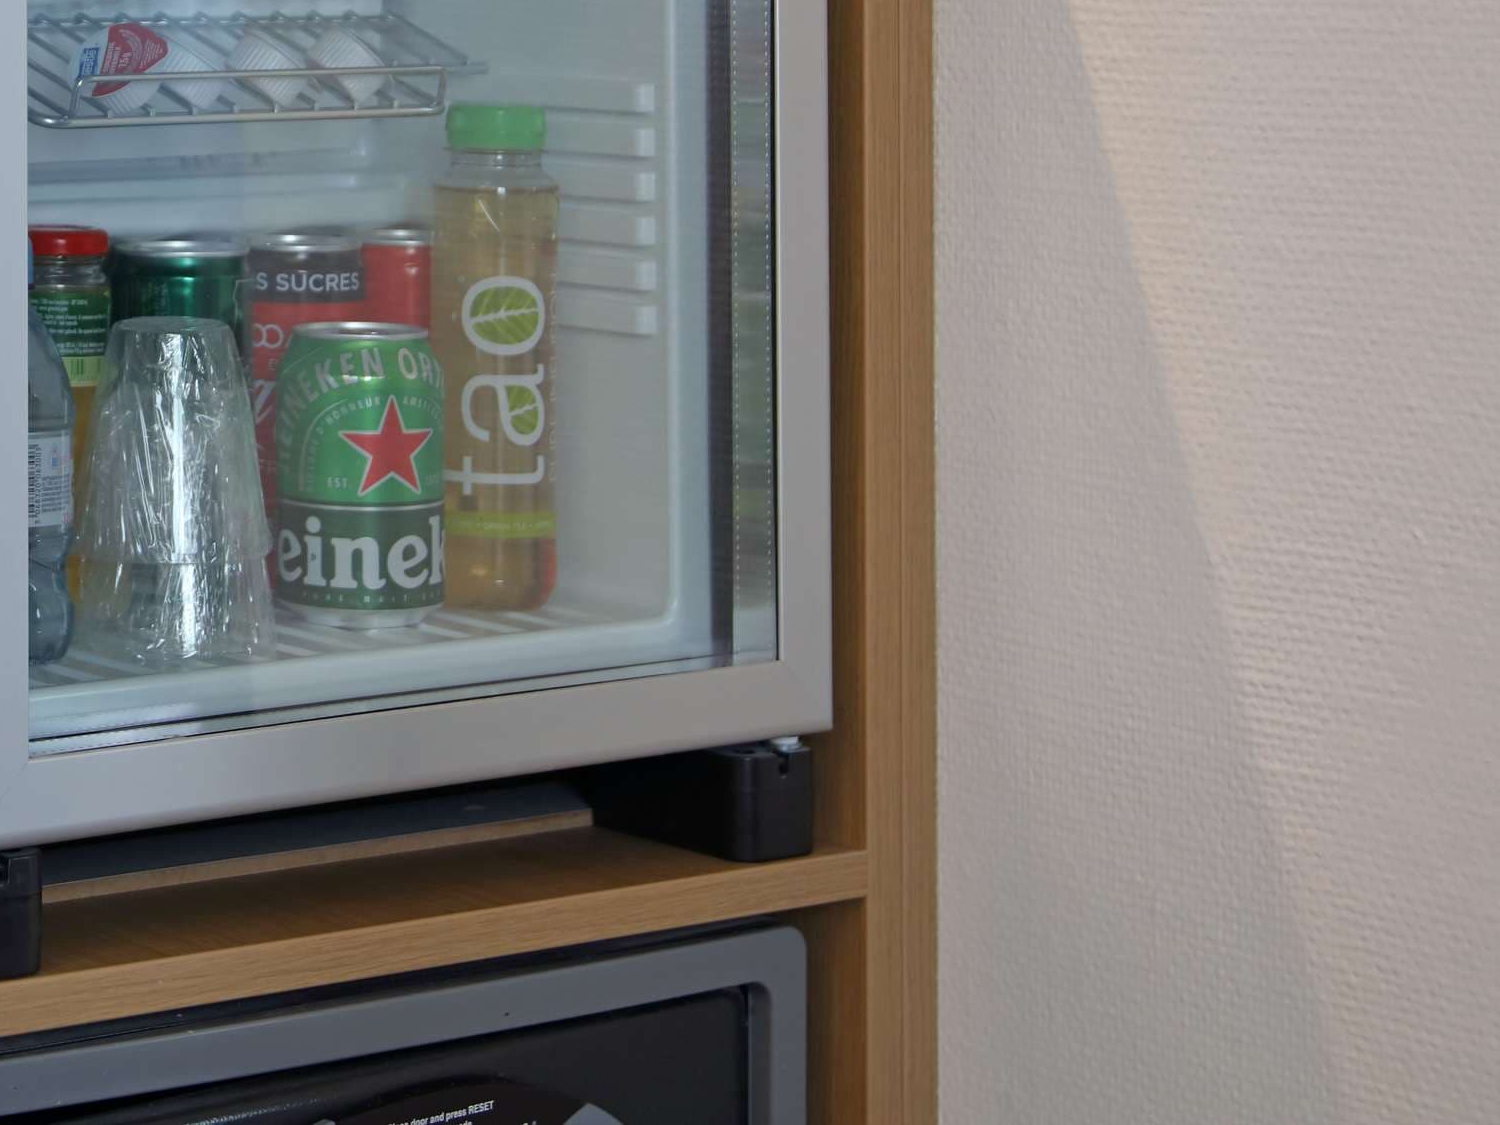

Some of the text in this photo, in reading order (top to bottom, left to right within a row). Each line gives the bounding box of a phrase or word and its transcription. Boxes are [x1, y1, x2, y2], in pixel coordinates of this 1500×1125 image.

[275, 271, 360, 292] SUCRES
[443, 275, 546, 496] tao
[430, 1110, 445, 1124] and
[445, 1107, 467, 1123] press
[467, 1099, 495, 1115] RESET
